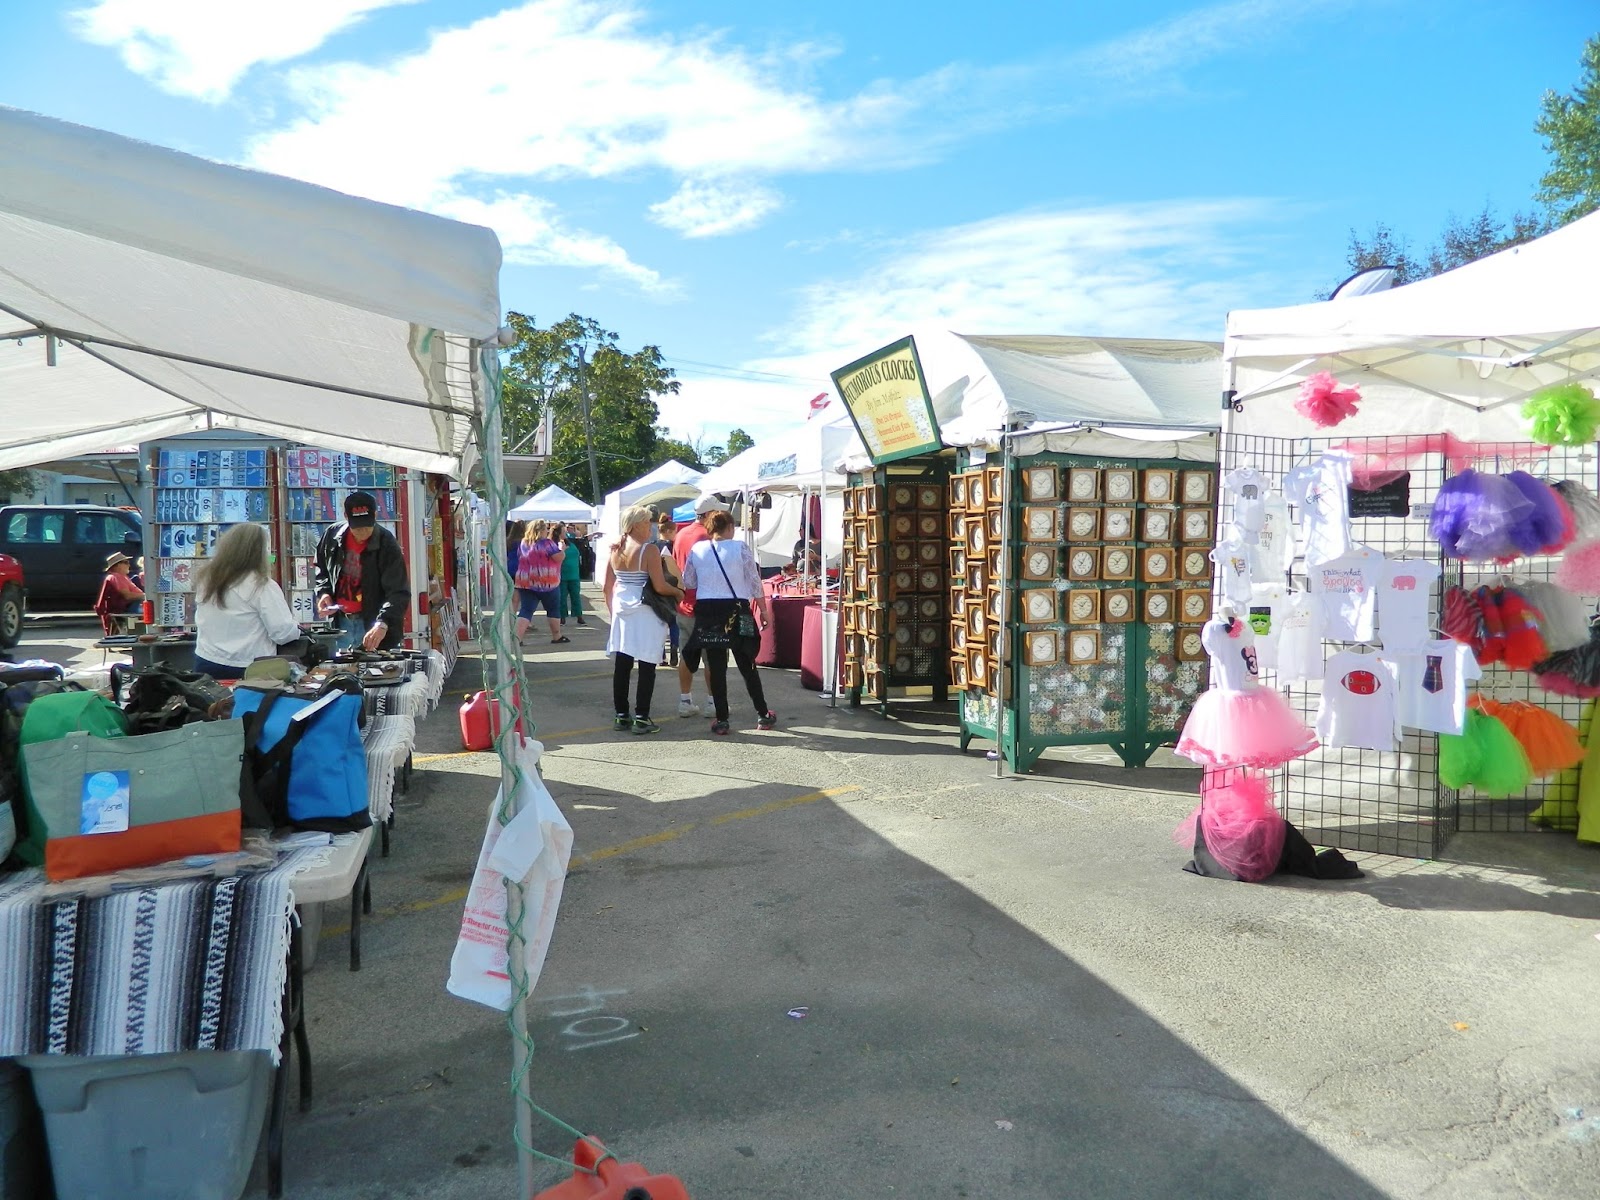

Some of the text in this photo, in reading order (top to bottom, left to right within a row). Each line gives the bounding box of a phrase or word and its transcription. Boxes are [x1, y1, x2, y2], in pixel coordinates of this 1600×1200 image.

[844, 363, 882, 406] HUMOROUS
[881, 359, 916, 382] CLOCKS
[203, 499, 211, 510] 99
